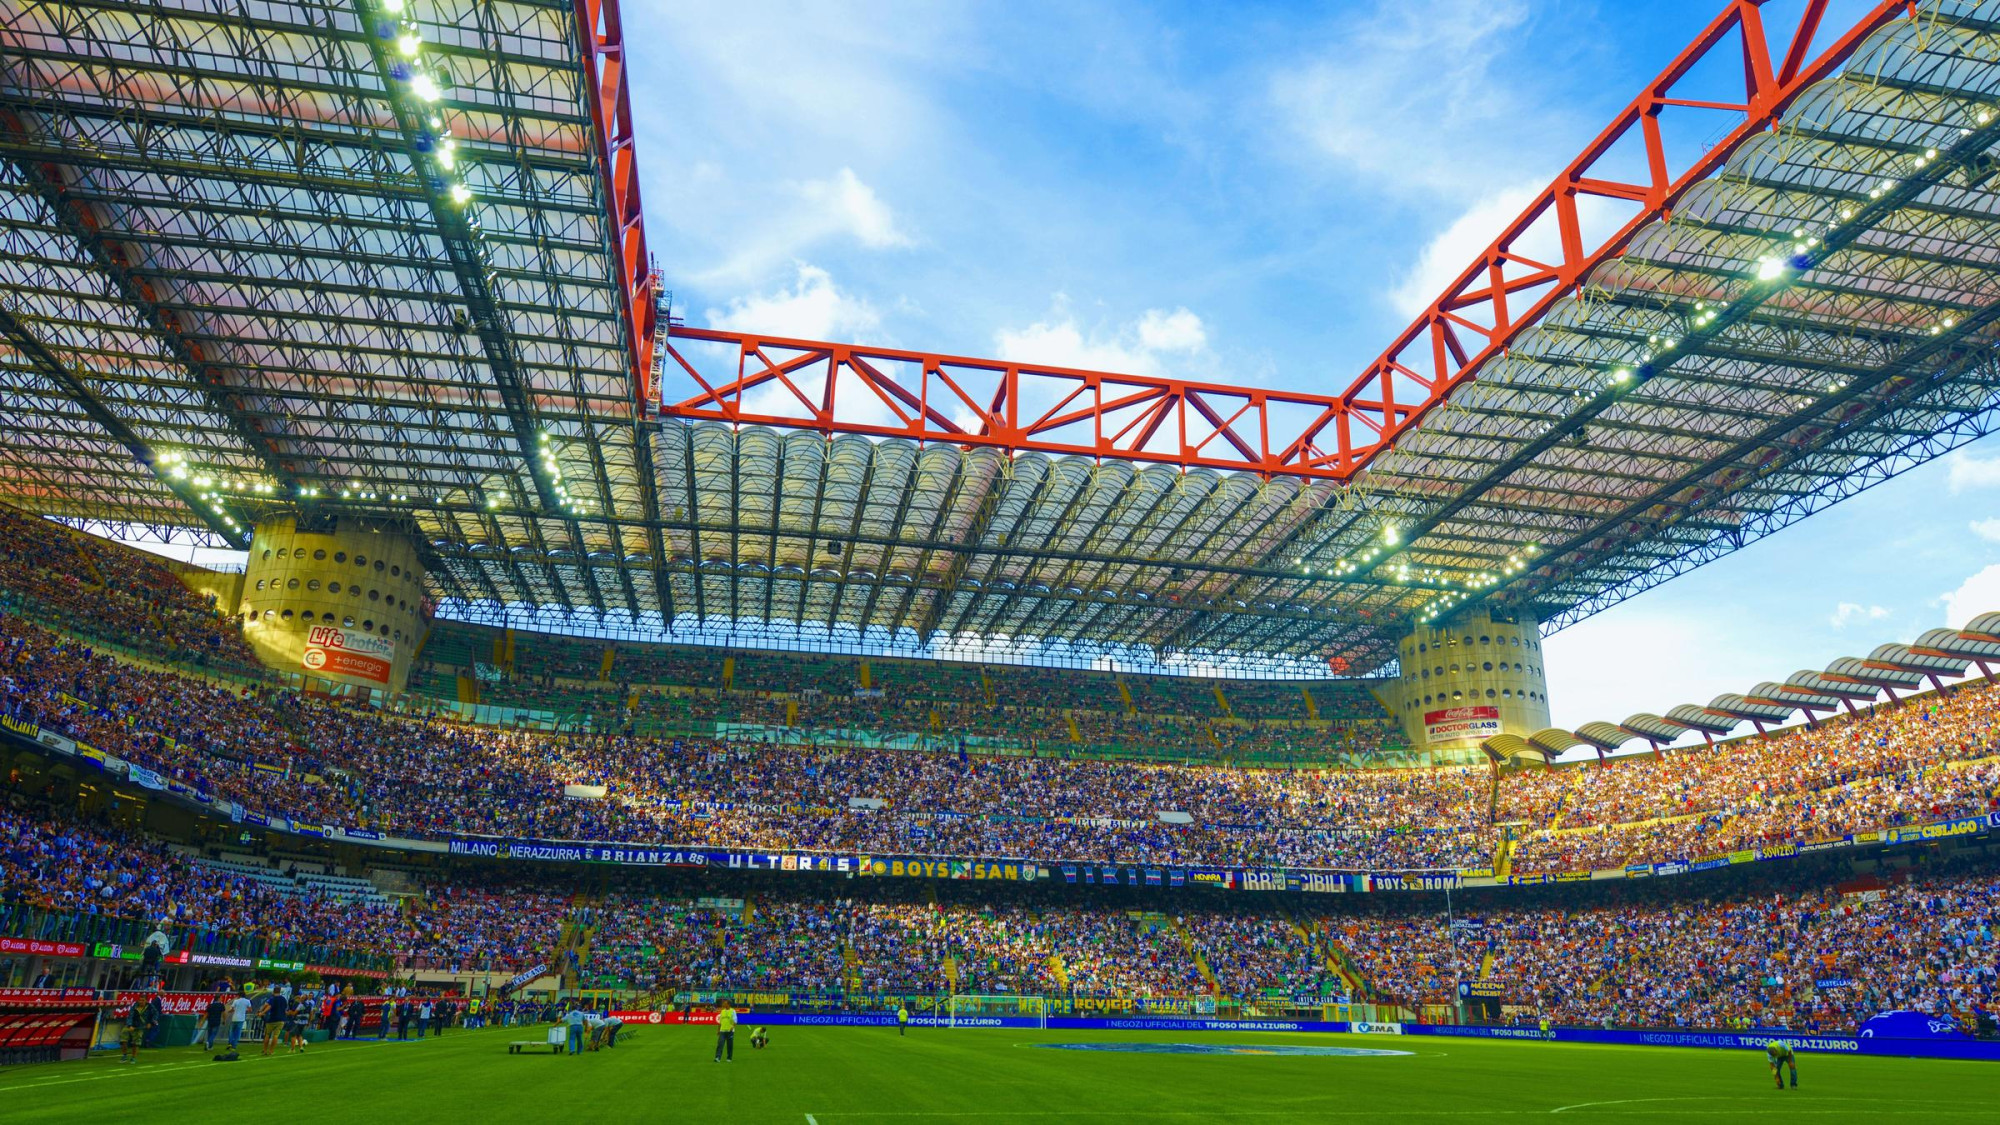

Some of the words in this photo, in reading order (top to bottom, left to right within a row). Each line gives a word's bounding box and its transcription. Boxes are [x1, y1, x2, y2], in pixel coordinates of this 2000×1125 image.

[1, 713, 39, 737] GALLARATE
[1436, 722, 1498, 733] DOCTORGLASS
[1922, 820, 1977, 837] CISLAGO
[450, 841, 498, 857] MILANO
[509, 845, 581, 861] NERAZZURRA
[601, 849, 684, 863] BRIANZA
[688, 852, 704, 865] 85
[1762, 845, 1795, 859] SOVIZZO
[892, 860, 949, 878] BOYS
[975, 863, 1018, 881] SAN
[1194, 873, 1221, 881] NOVARA
[1377, 877, 1408, 890] BOYS
[1425, 876, 1463, 890] ROMA
[192, 953, 252, 967] www.tecnovision.com
[174, 997, 191, 1012] Lete
[191, 997, 208, 1012] Lete
[836, 1017, 879, 1025] UFFICIALI
[881, 1017, 898, 1025] DEL
[907, 1018, 936, 1026] IFOSO
[937, 1018, 1002, 1027] NERAZZURRO
[1111, 1020, 1144, 1028] NEGOZI
[1145, 1020, 1184, 1028] UFFICIALI
[1187, 1021, 1204, 1029] DEL
[1205, 1022, 1238, 1030] TIFOSO
[1239, 1022, 1298, 1030] NERAZZURRO
[1359, 1023, 1395, 1034] VEMA
[1435, 1027, 1454, 1035] NEGOZI
[1454, 1027, 1478, 1036] UFFICIALI
[1479, 1028, 1490, 1036] DEL
[1491, 1028, 1512, 1037] TIFOSO
[1643, 1034, 1674, 1043] NEGOZI
[1676, 1035, 1716, 1045] UFFICIALI
[1717, 1036, 1737, 1046] DEL
